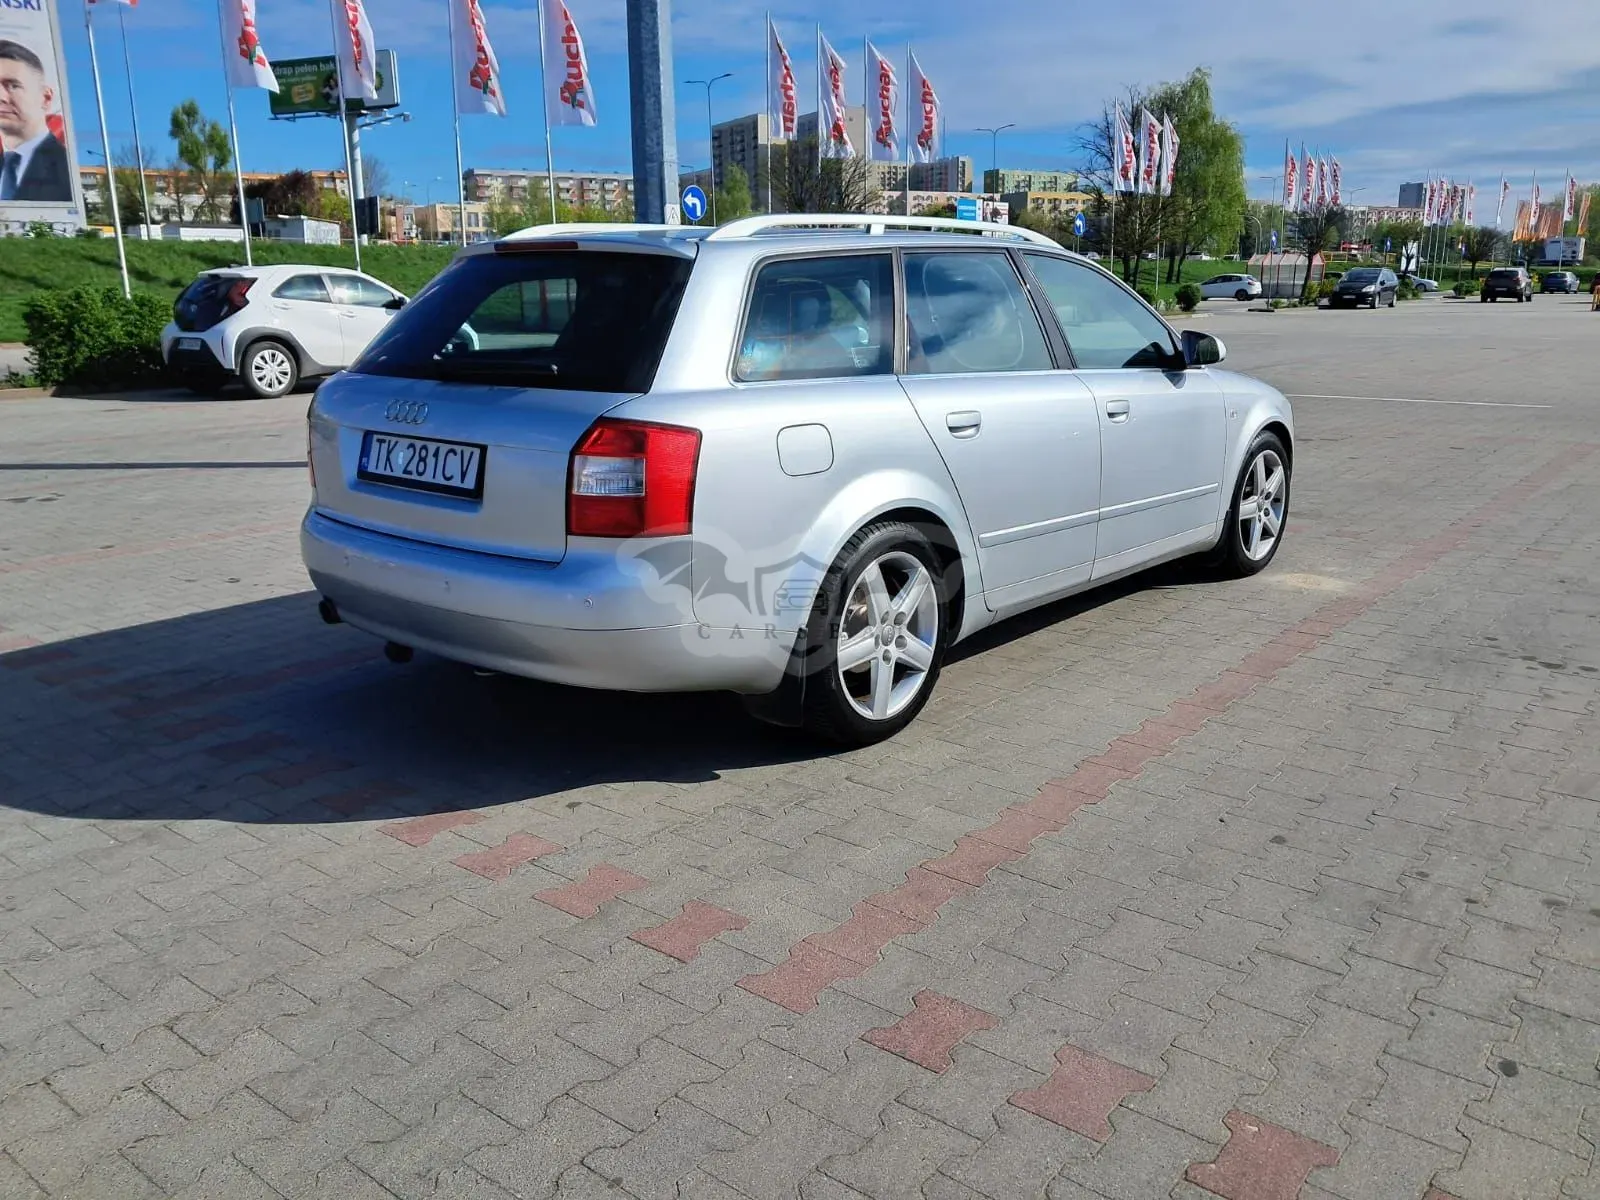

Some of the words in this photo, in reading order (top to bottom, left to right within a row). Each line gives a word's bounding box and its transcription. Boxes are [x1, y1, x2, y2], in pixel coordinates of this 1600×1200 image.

[272, 66, 293, 76] drap
[375, 438, 399, 472] TK
[402, 442, 474, 484] 281CV
